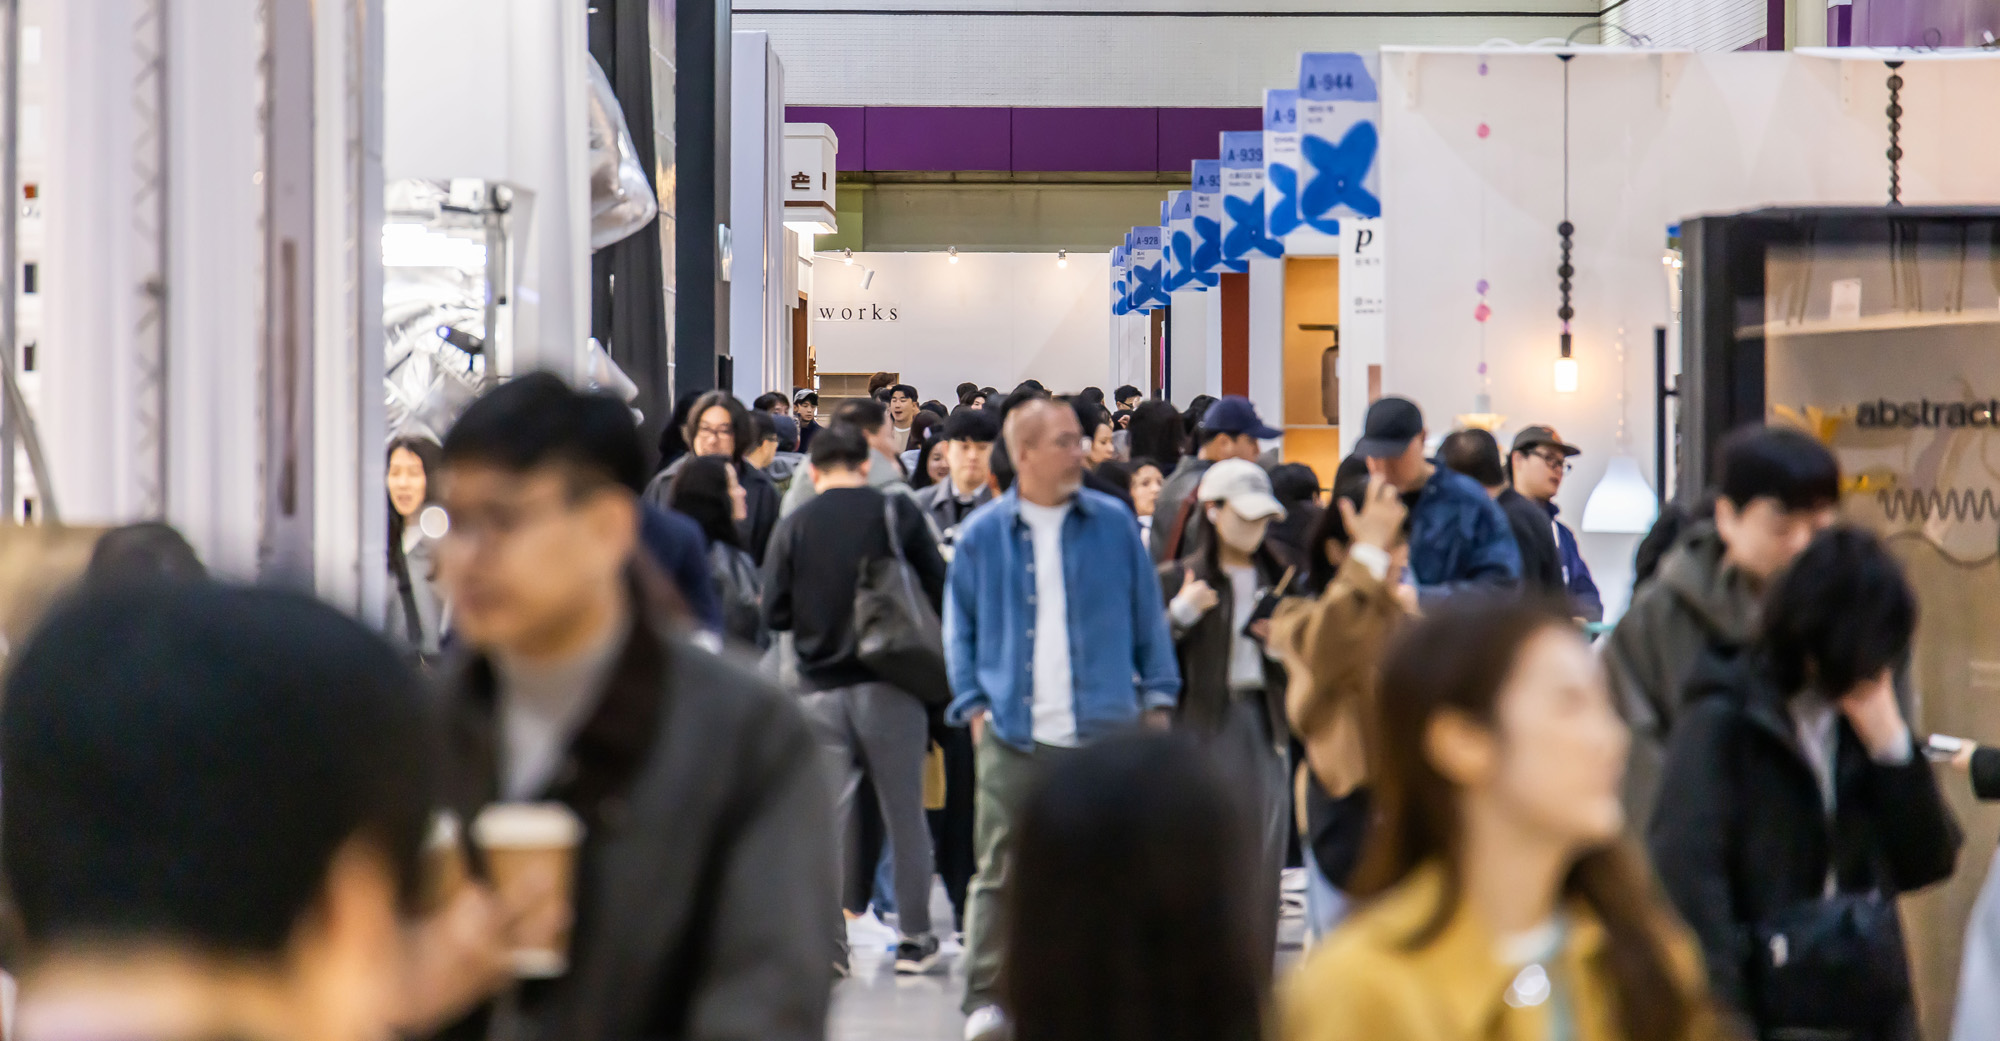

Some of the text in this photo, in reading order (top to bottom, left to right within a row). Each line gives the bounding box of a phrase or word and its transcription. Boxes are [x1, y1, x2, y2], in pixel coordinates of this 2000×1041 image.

[1227, 148, 1263, 162] A-939
[1136, 236, 1159, 245] A-928
[819, 303, 899, 320] works
[1856, 397, 2000, 428] abstract
